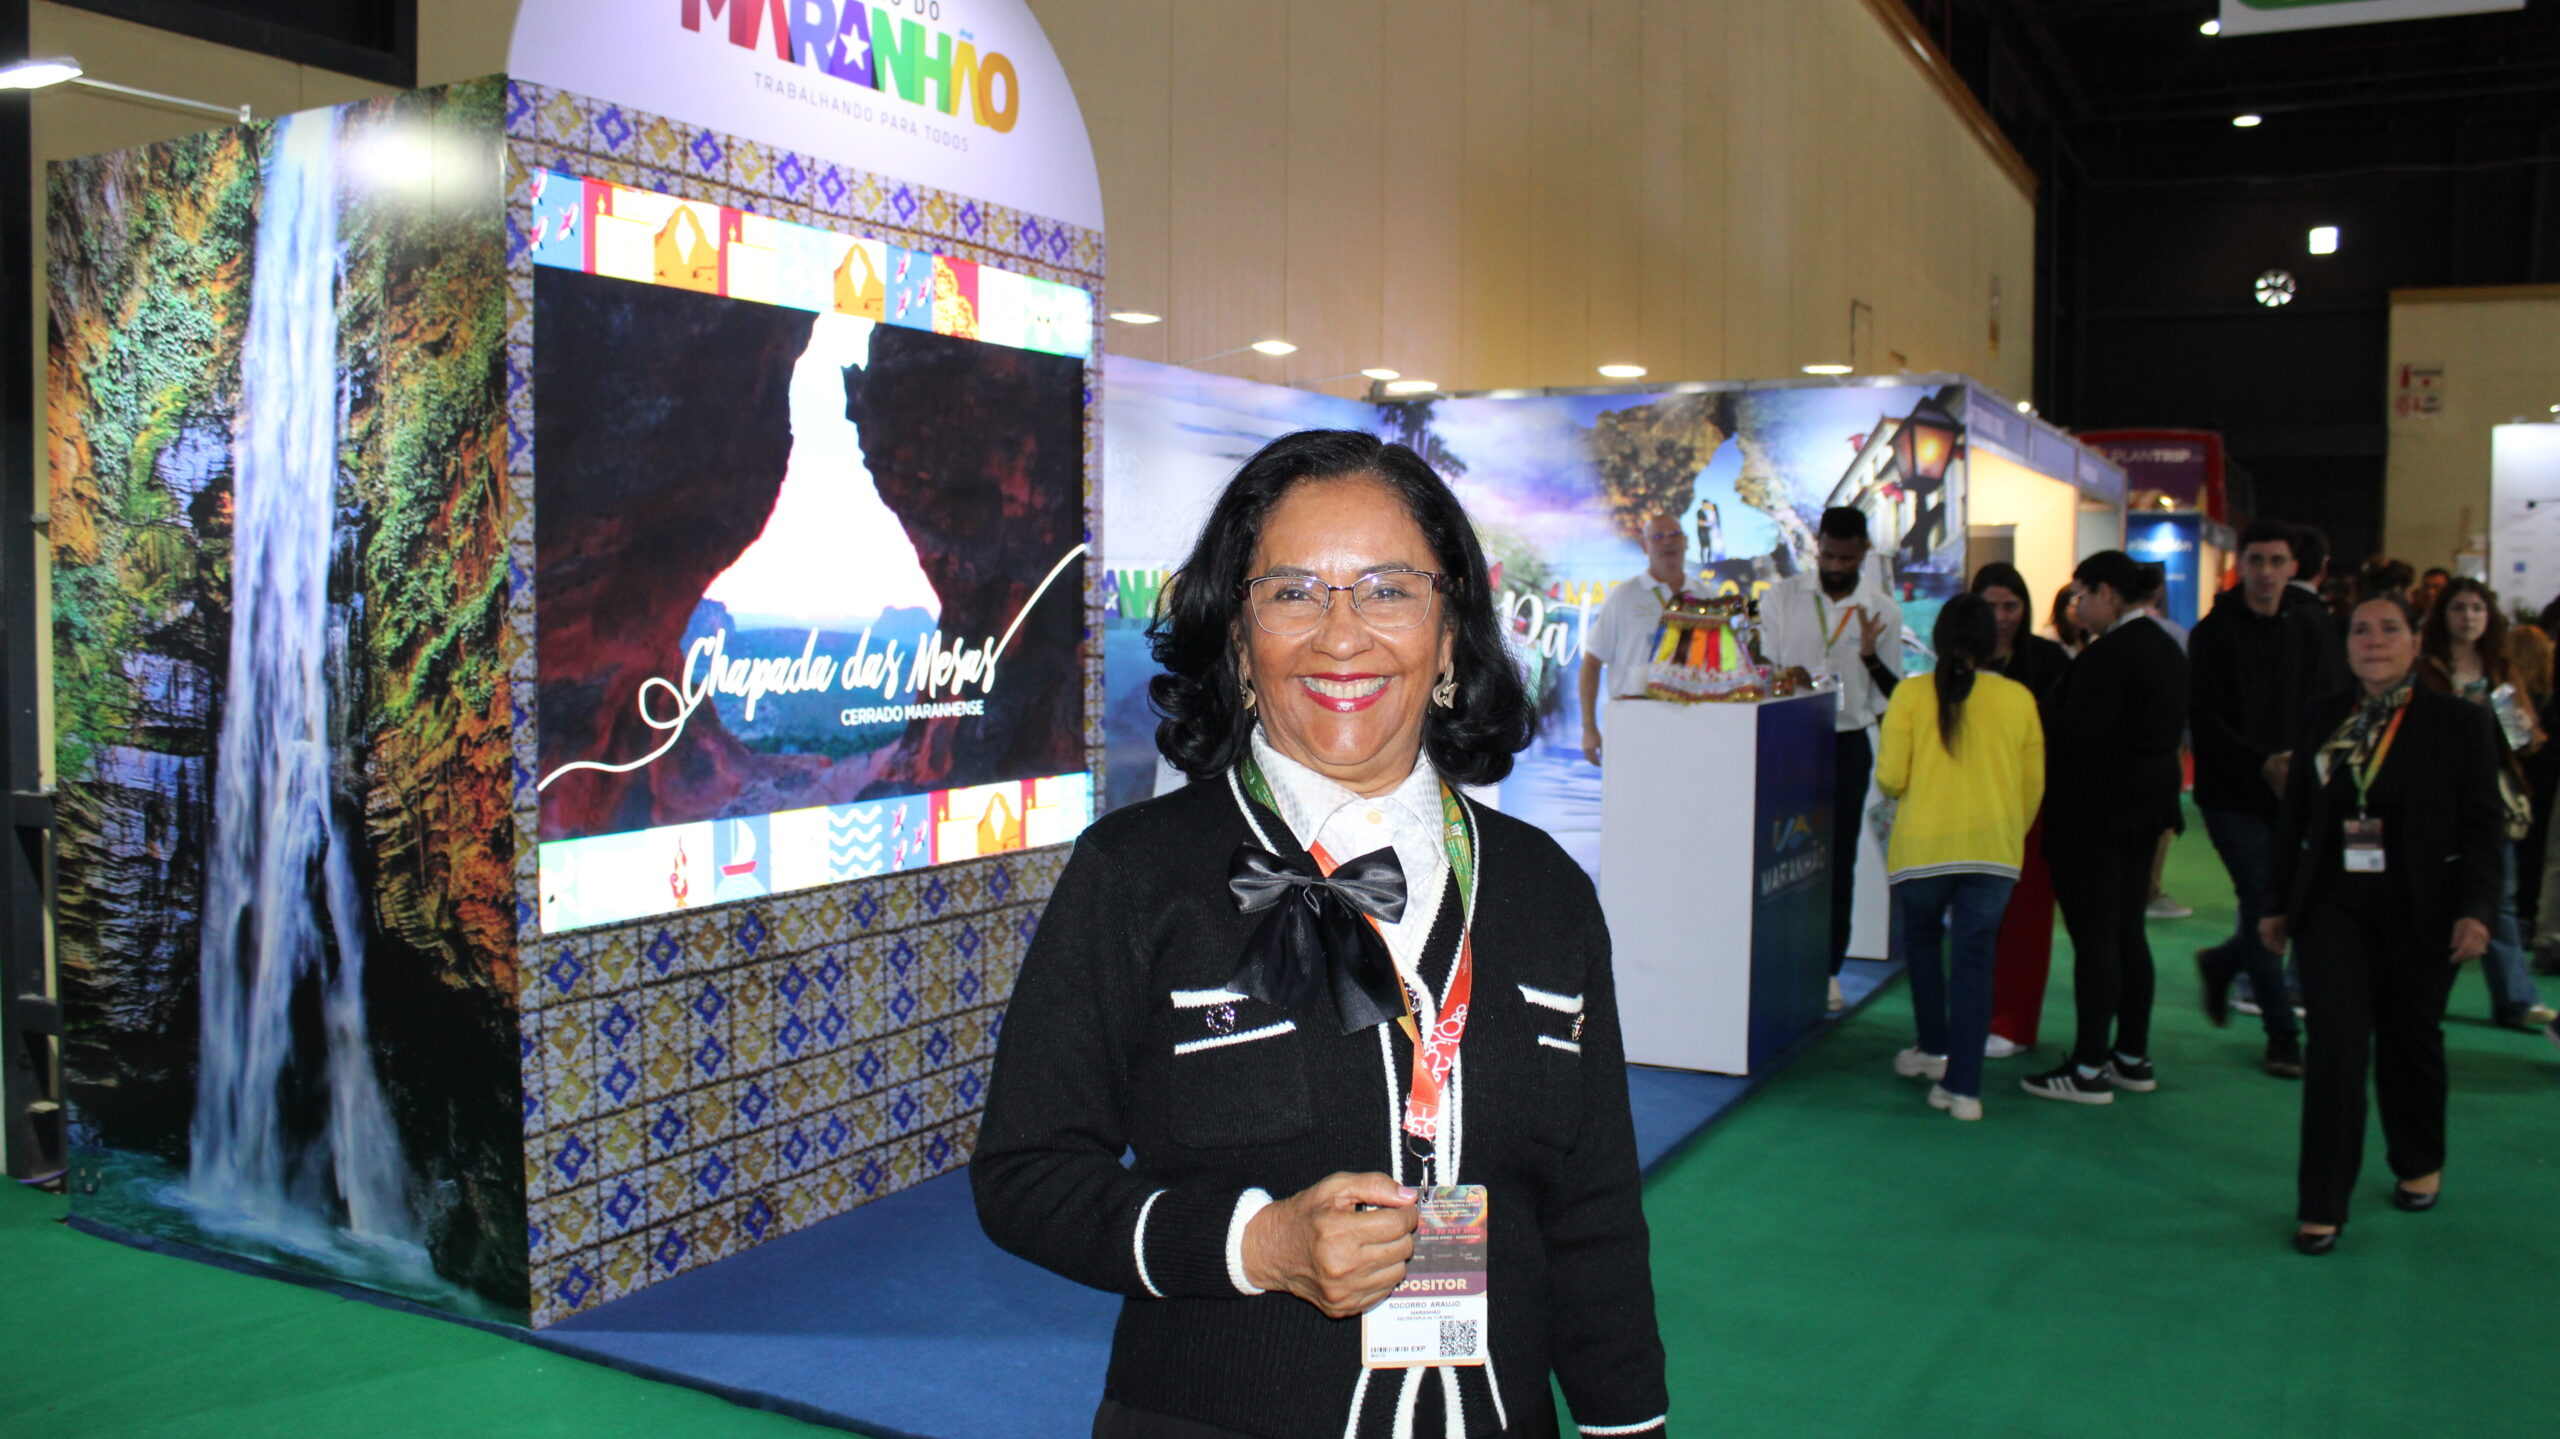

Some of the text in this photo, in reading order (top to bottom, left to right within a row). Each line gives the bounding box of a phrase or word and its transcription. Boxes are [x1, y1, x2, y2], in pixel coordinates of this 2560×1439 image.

[754, 71, 969, 153] TRABALHANDO PARA TODOS
[682, 626, 1001, 721] Chapada das Mesas
[841, 699, 985, 727] CERRADO MARANHENSE
[1761, 841, 1826, 897] MARANHÃO
[1394, 1278, 1467, 1292] POSITOR
